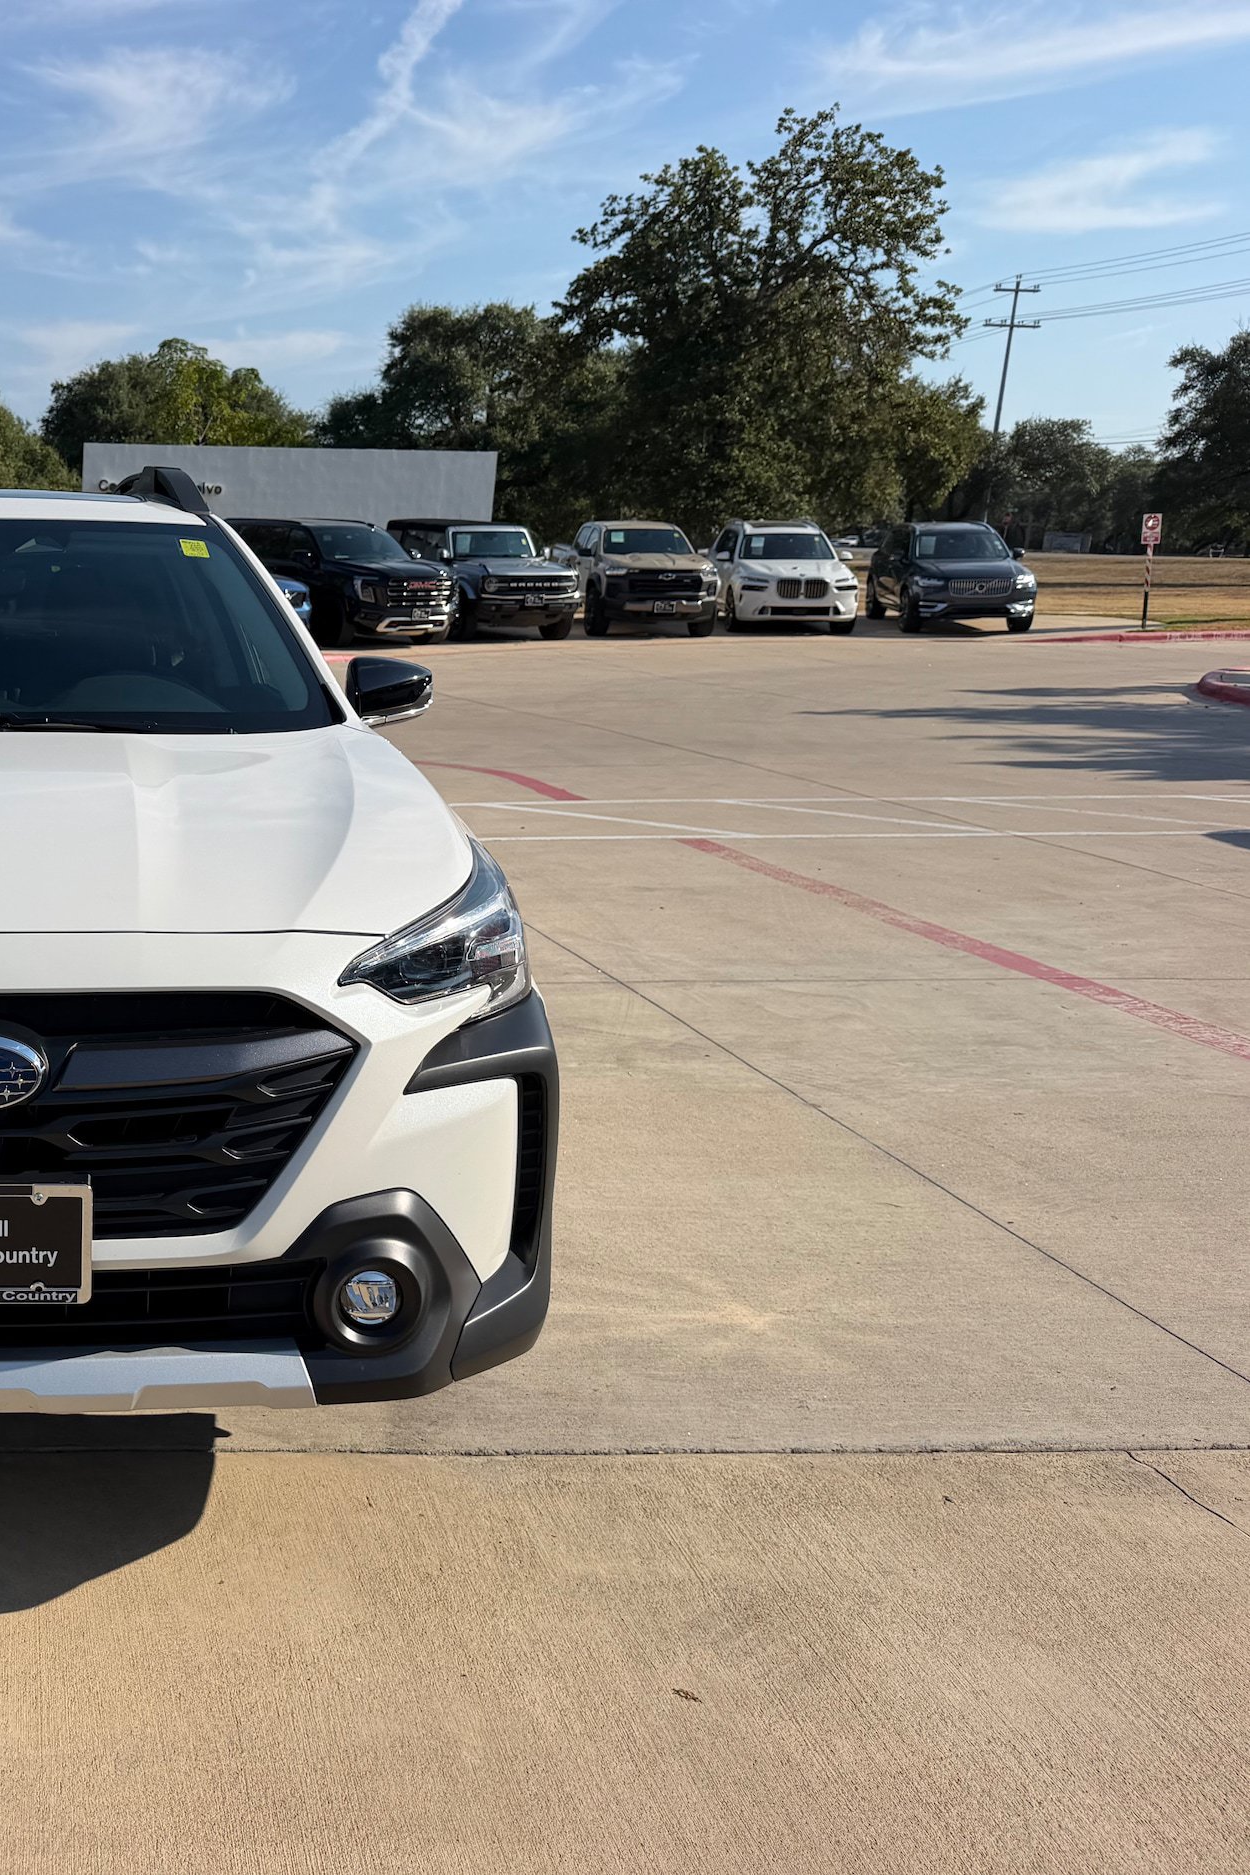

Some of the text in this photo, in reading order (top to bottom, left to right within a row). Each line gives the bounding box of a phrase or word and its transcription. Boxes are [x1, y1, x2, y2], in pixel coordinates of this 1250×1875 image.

[197, 482, 222, 495] lvo
[408, 581, 438, 590] GMC
[2, 1291, 77, 1303] Country
